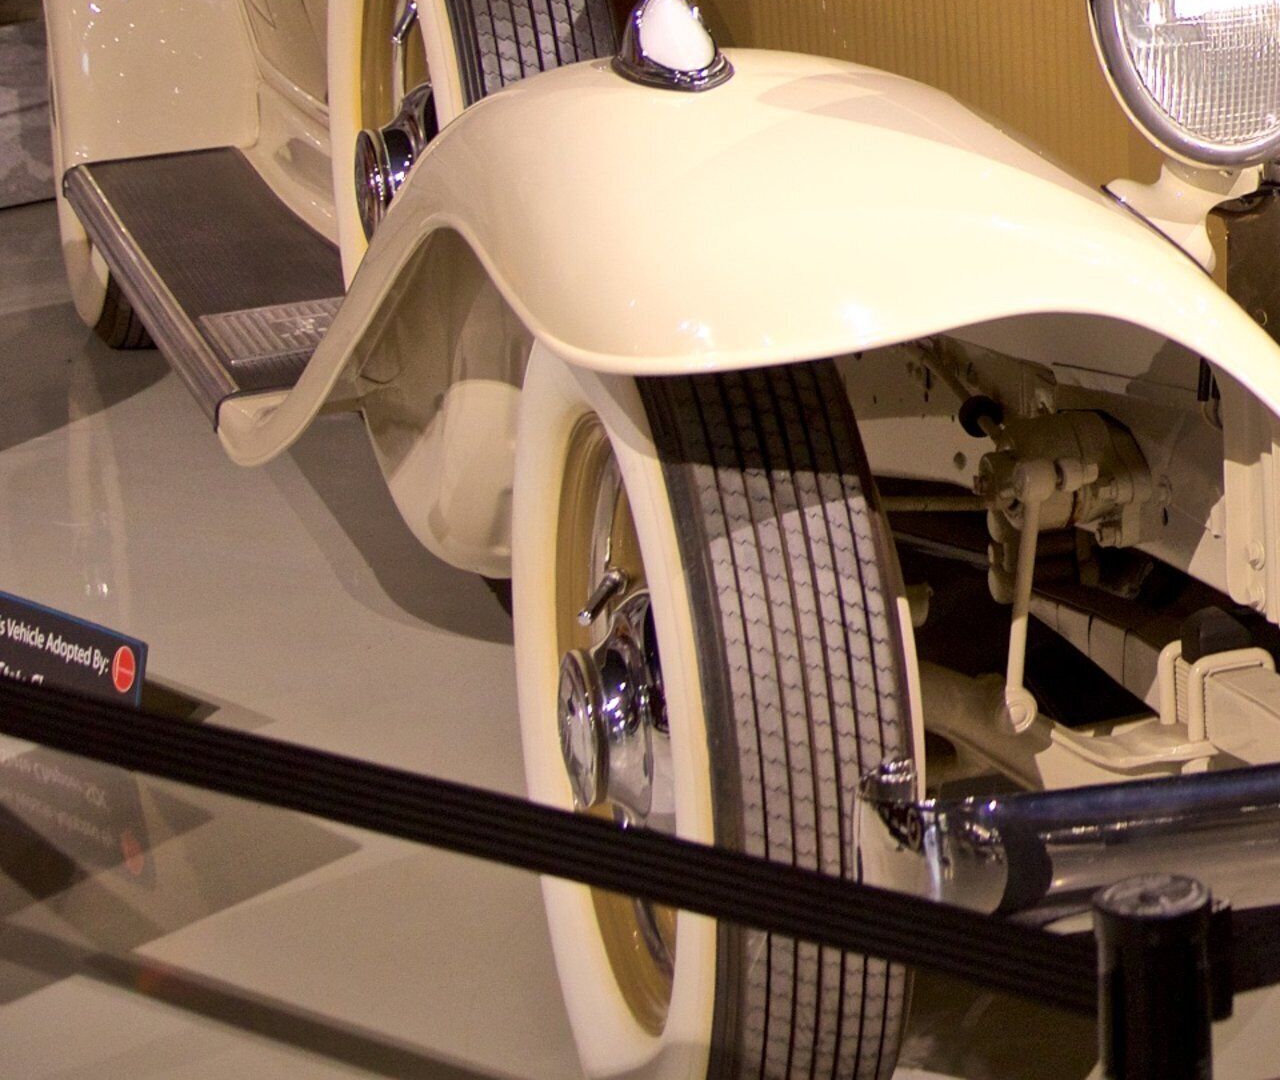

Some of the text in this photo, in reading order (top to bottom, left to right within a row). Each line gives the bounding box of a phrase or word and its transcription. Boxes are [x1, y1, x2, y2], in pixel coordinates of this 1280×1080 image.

[7, 618, 45, 649] Vehicle
[45, 632, 93, 665] Adopted
[93, 649, 110, 677] By:
